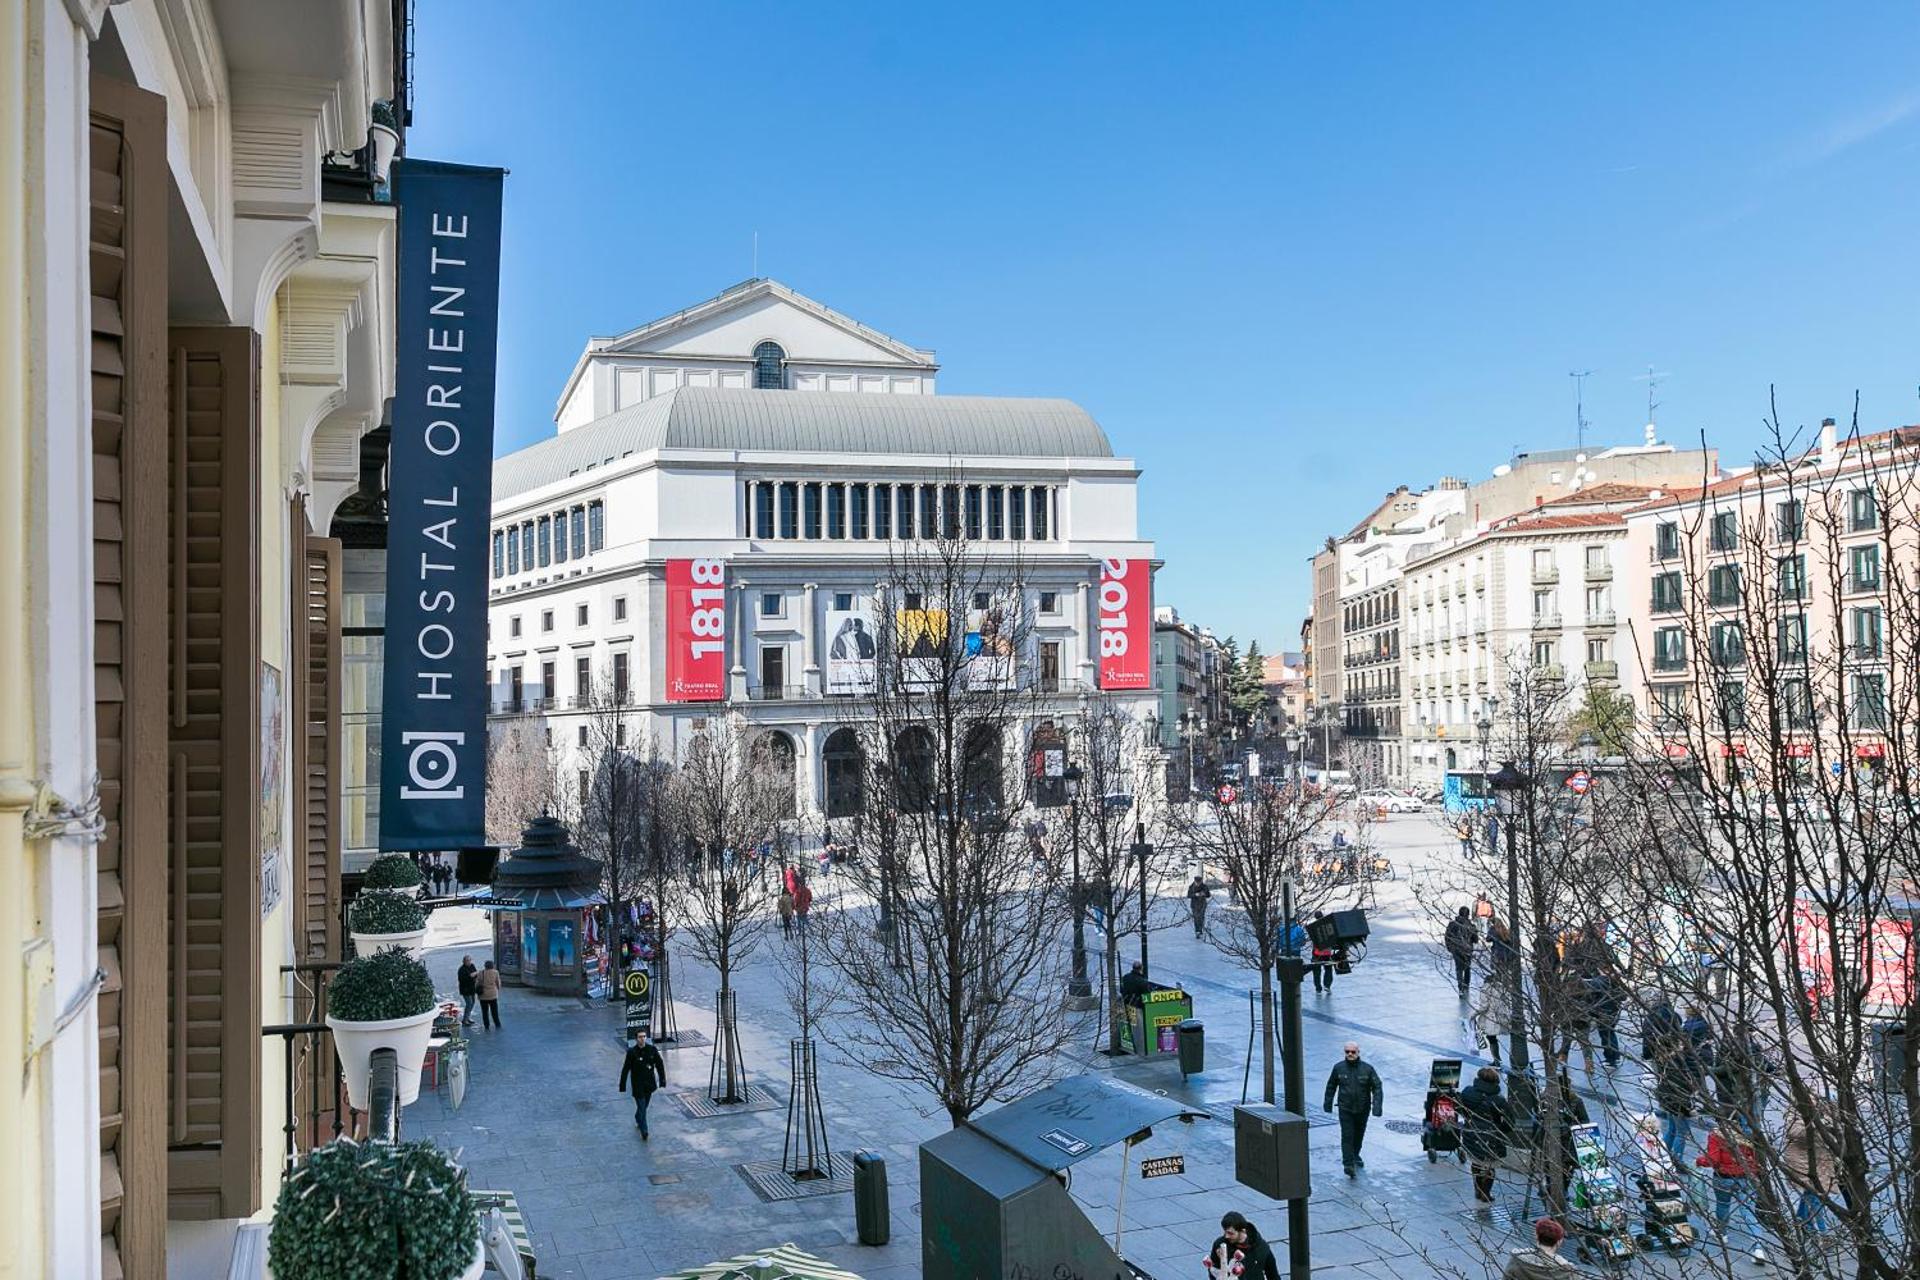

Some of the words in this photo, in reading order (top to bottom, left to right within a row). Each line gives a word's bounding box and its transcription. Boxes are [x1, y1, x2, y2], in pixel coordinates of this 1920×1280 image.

[424, 212, 469, 457] ORIENTE
[417, 486, 459, 700] HOSTAL
[690, 558, 724, 661] 1818
[1101, 558, 1129, 659] 2018
[1152, 991, 1182, 1002] ONCE
